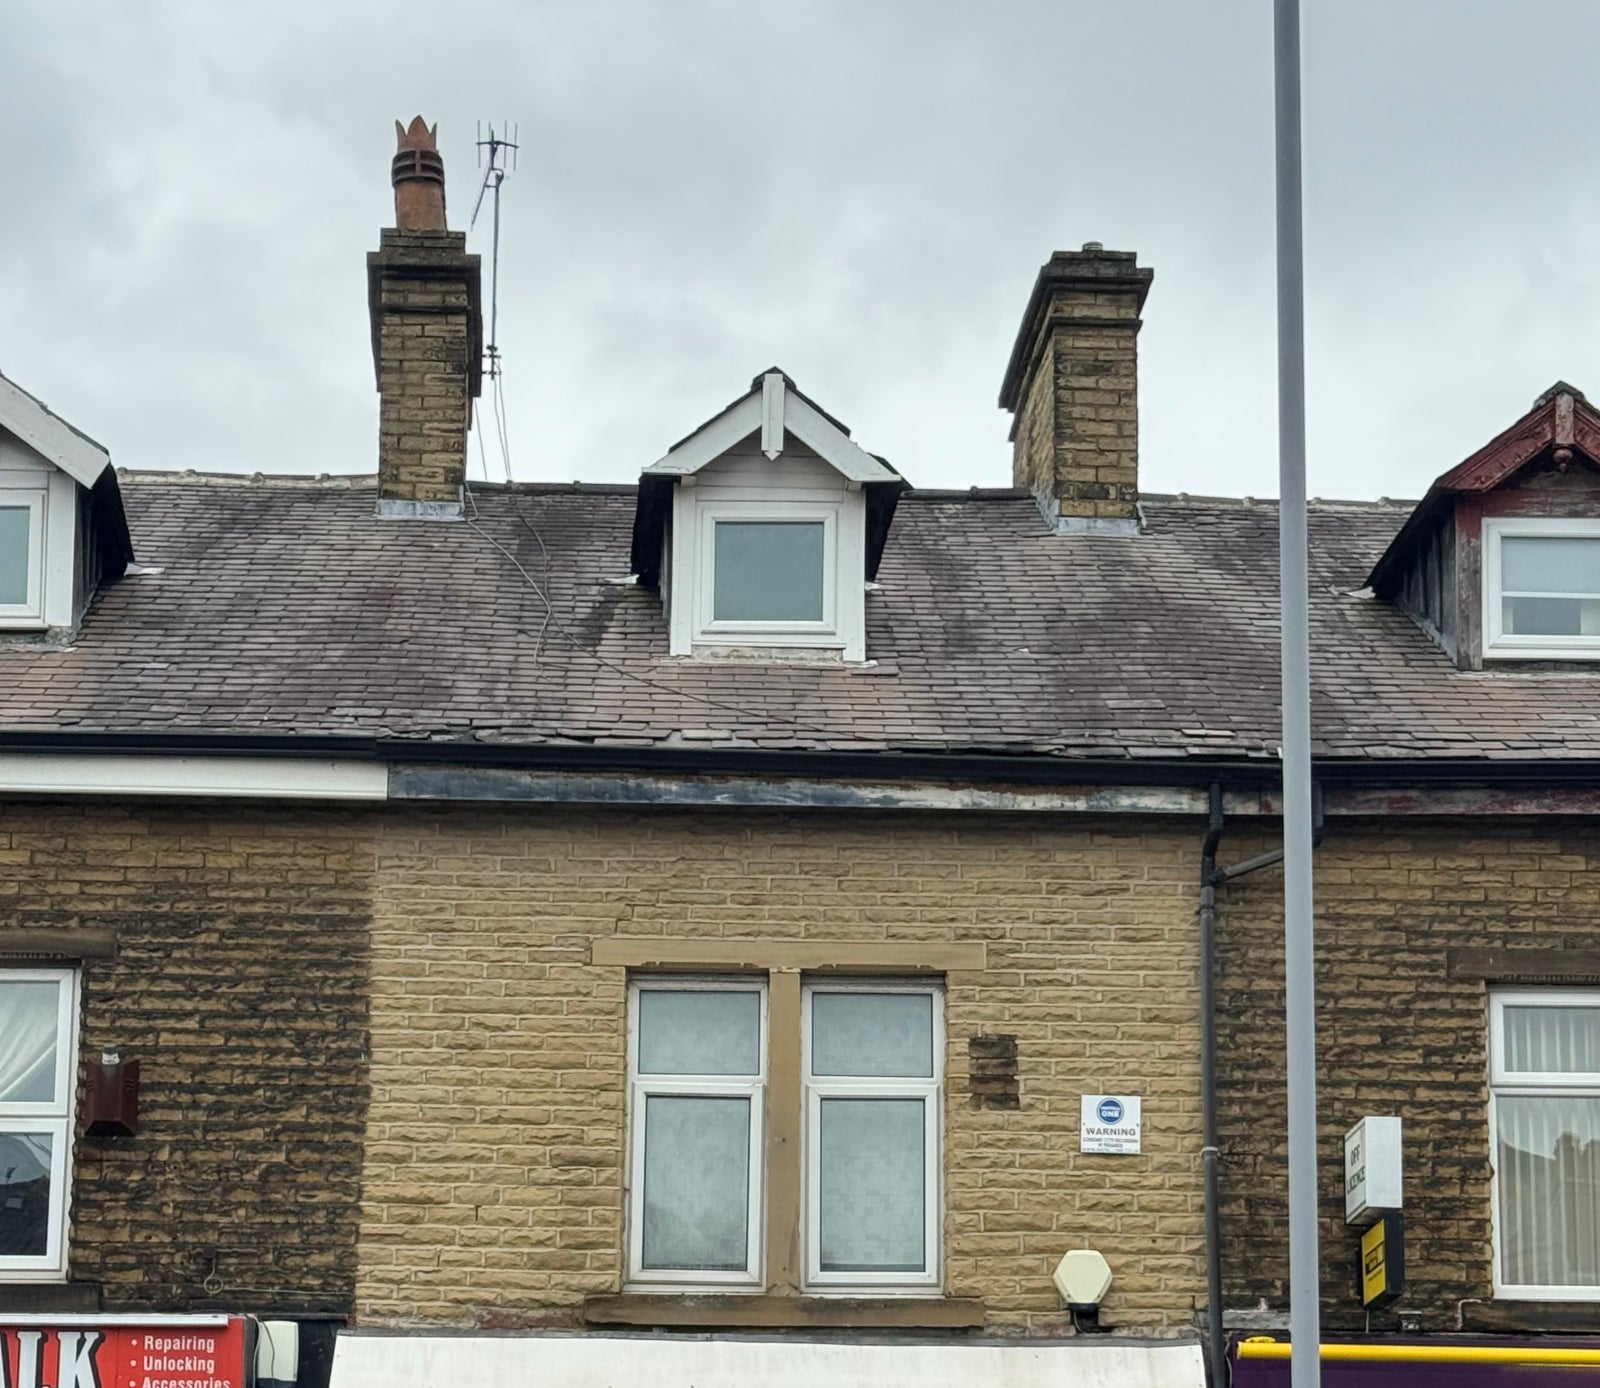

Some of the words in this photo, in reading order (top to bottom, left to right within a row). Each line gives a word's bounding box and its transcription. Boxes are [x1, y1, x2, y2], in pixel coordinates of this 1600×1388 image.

[1085, 1127, 1136, 1136] WARNING
[144, 1335, 215, 1354] Repairing
[143, 1356, 215, 1374] Unlocking
[142, 1377, 231, 1388] Accessories
